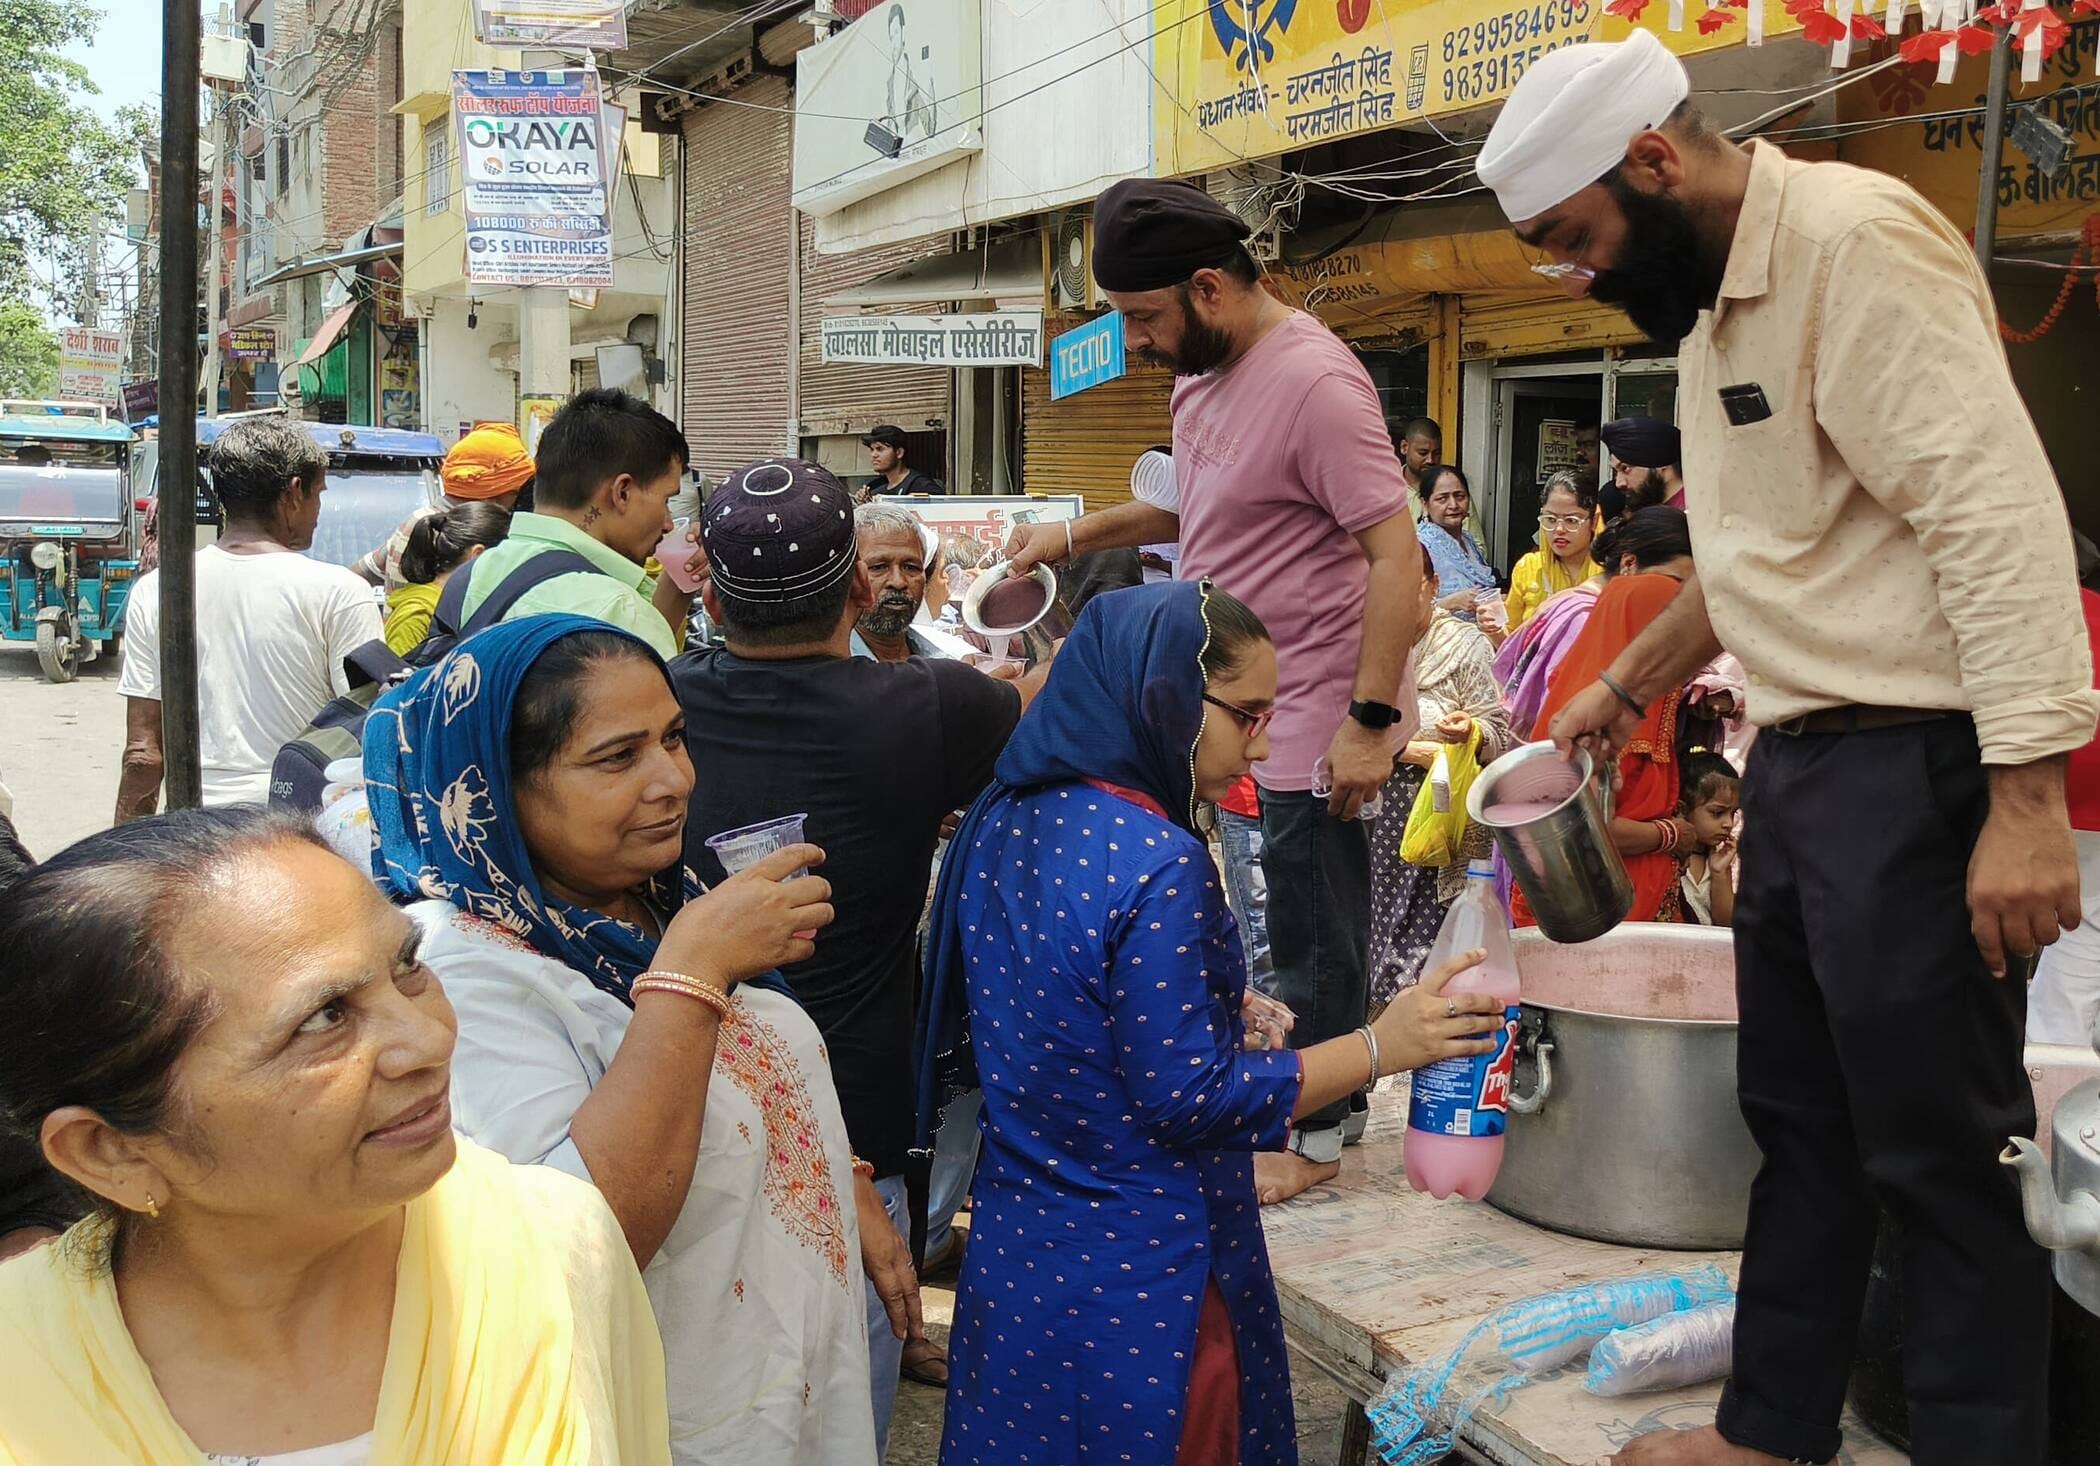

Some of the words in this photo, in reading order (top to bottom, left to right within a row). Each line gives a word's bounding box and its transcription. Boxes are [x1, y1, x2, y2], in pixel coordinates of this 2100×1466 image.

[1286, 52, 1356, 106] चरनजीत
[1357, 46, 1393, 88] सिंह
[1442, 35, 1590, 102] 9839135
[458, 90, 496, 113] सोलर
[526, 91, 550, 113] टॉप
[553, 90, 598, 114] योजना
[1285, 95, 1357, 142] परमजीत
[1357, 89, 1395, 127] सिंह
[466, 119, 597, 151] OKAYA
[508, 160, 590, 176] SOLAR
[475, 216, 525, 229] 108000
[488, 239, 498, 253] S
[501, 239, 510, 254] S
[514, 240, 608, 255] ENTERPRISES
[472, 273, 504, 282] CONTACT
[881, 321, 946, 361] मोबाइल
[1059, 330, 1111, 384] TECNO
